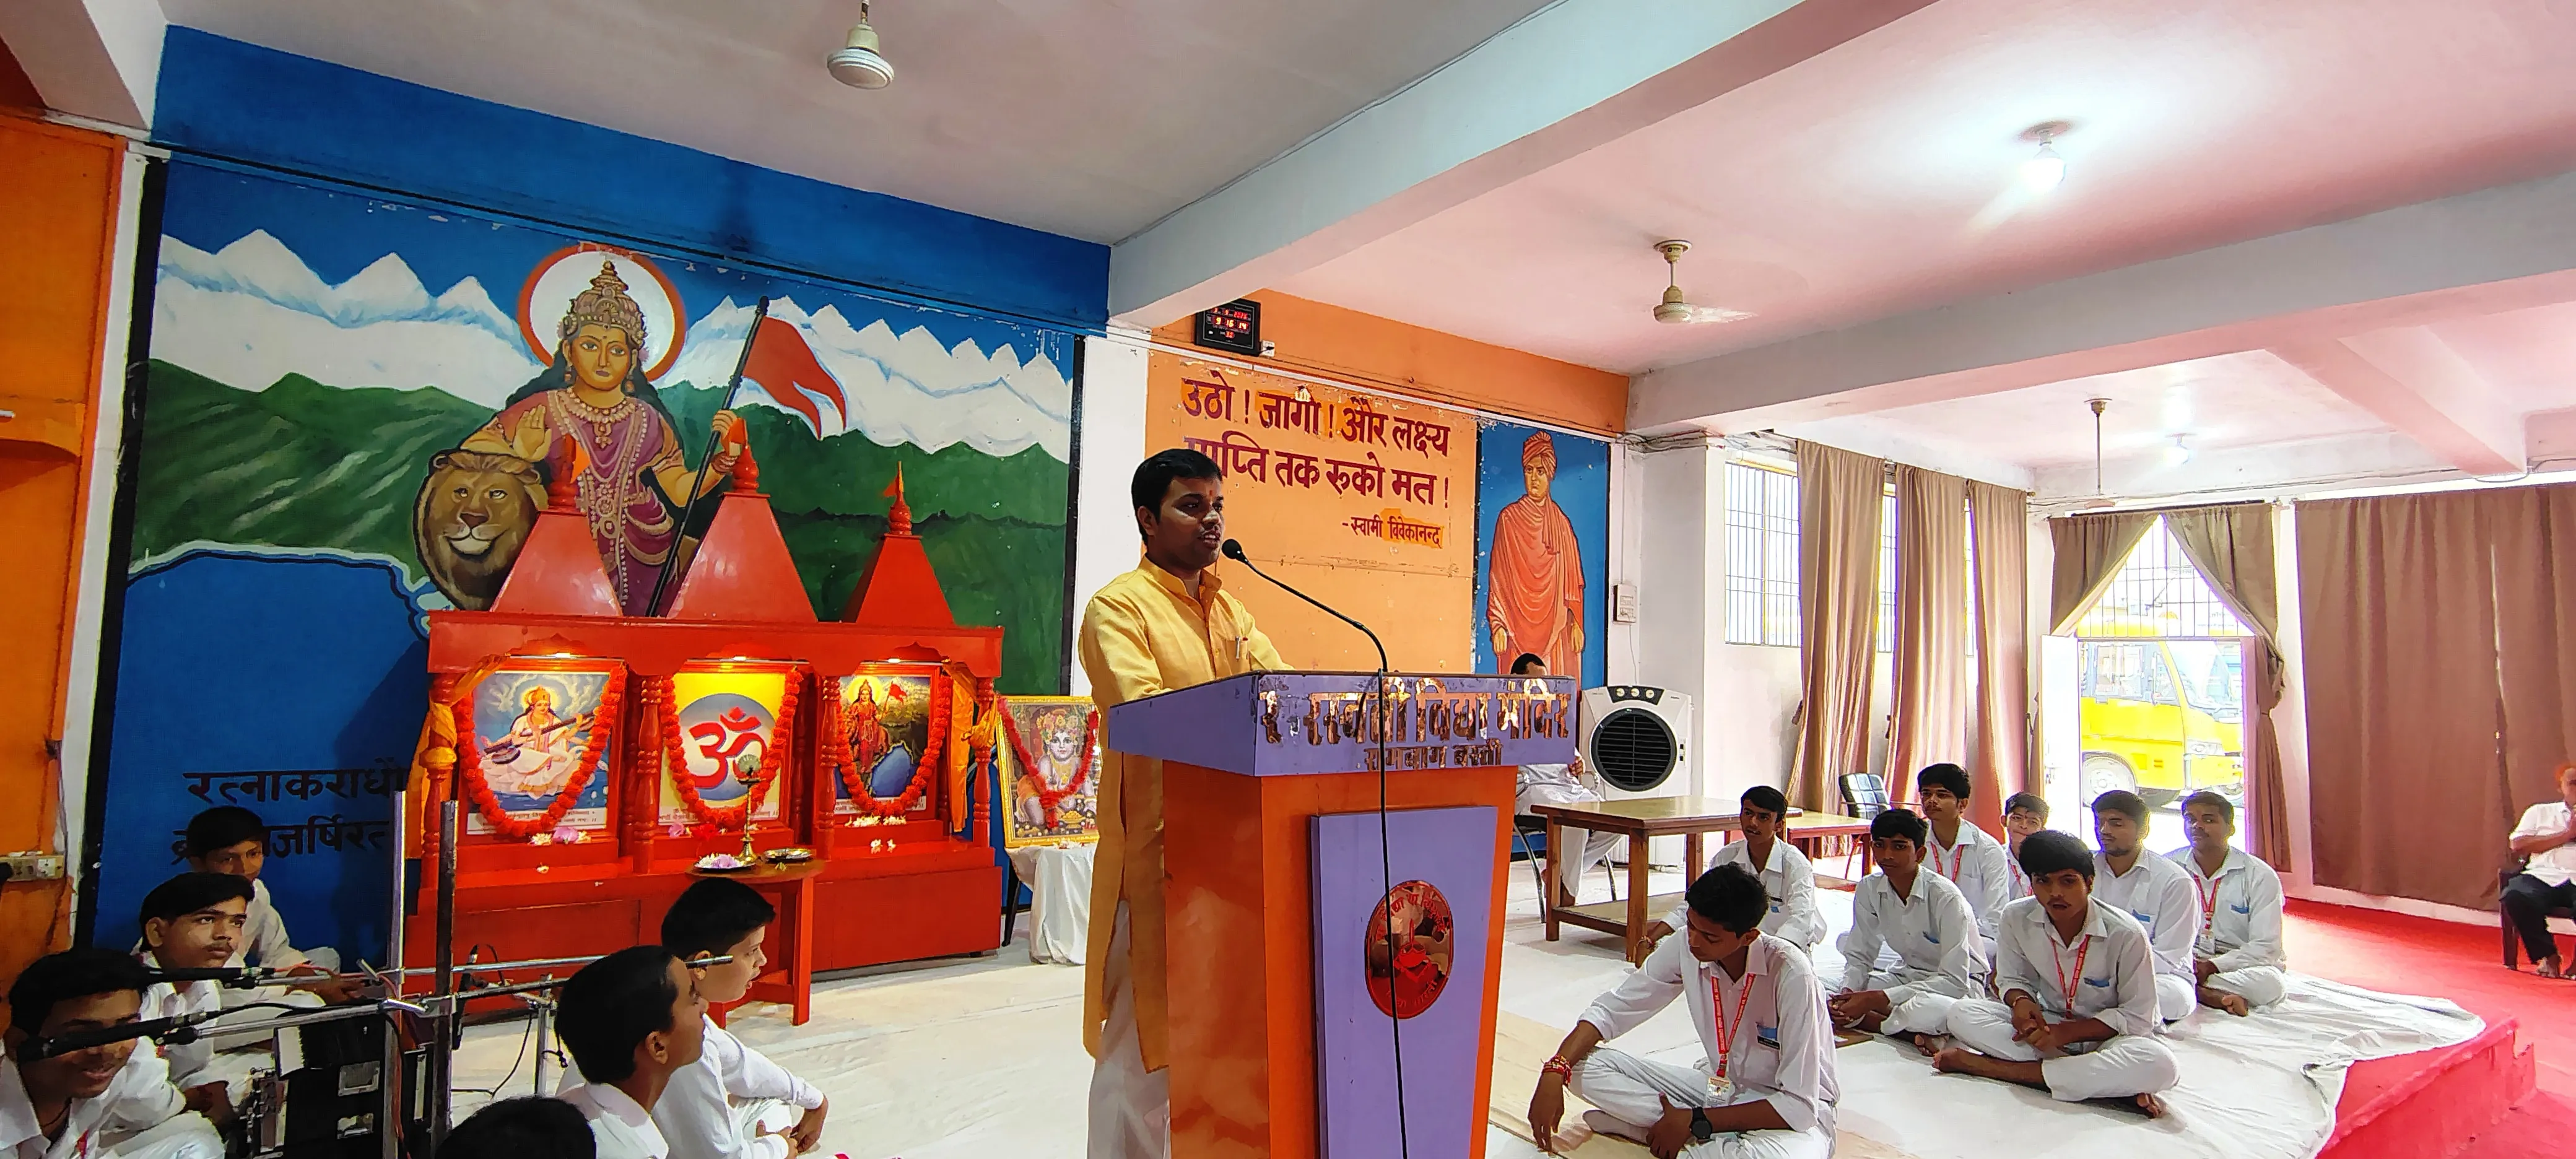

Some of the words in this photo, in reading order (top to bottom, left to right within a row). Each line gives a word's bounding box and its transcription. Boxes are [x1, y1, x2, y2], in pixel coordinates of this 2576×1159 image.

[1181, 370, 1236, 422] उठो
[1258, 384, 1322, 435] जागो
[1340, 396, 1390, 448] और
[1393, 416, 1451, 459] लक्ष्य
[1274, 450, 1320, 489] तक
[1391, 469, 1438, 506] मत
[1416, 677, 1492, 742] विद्या
